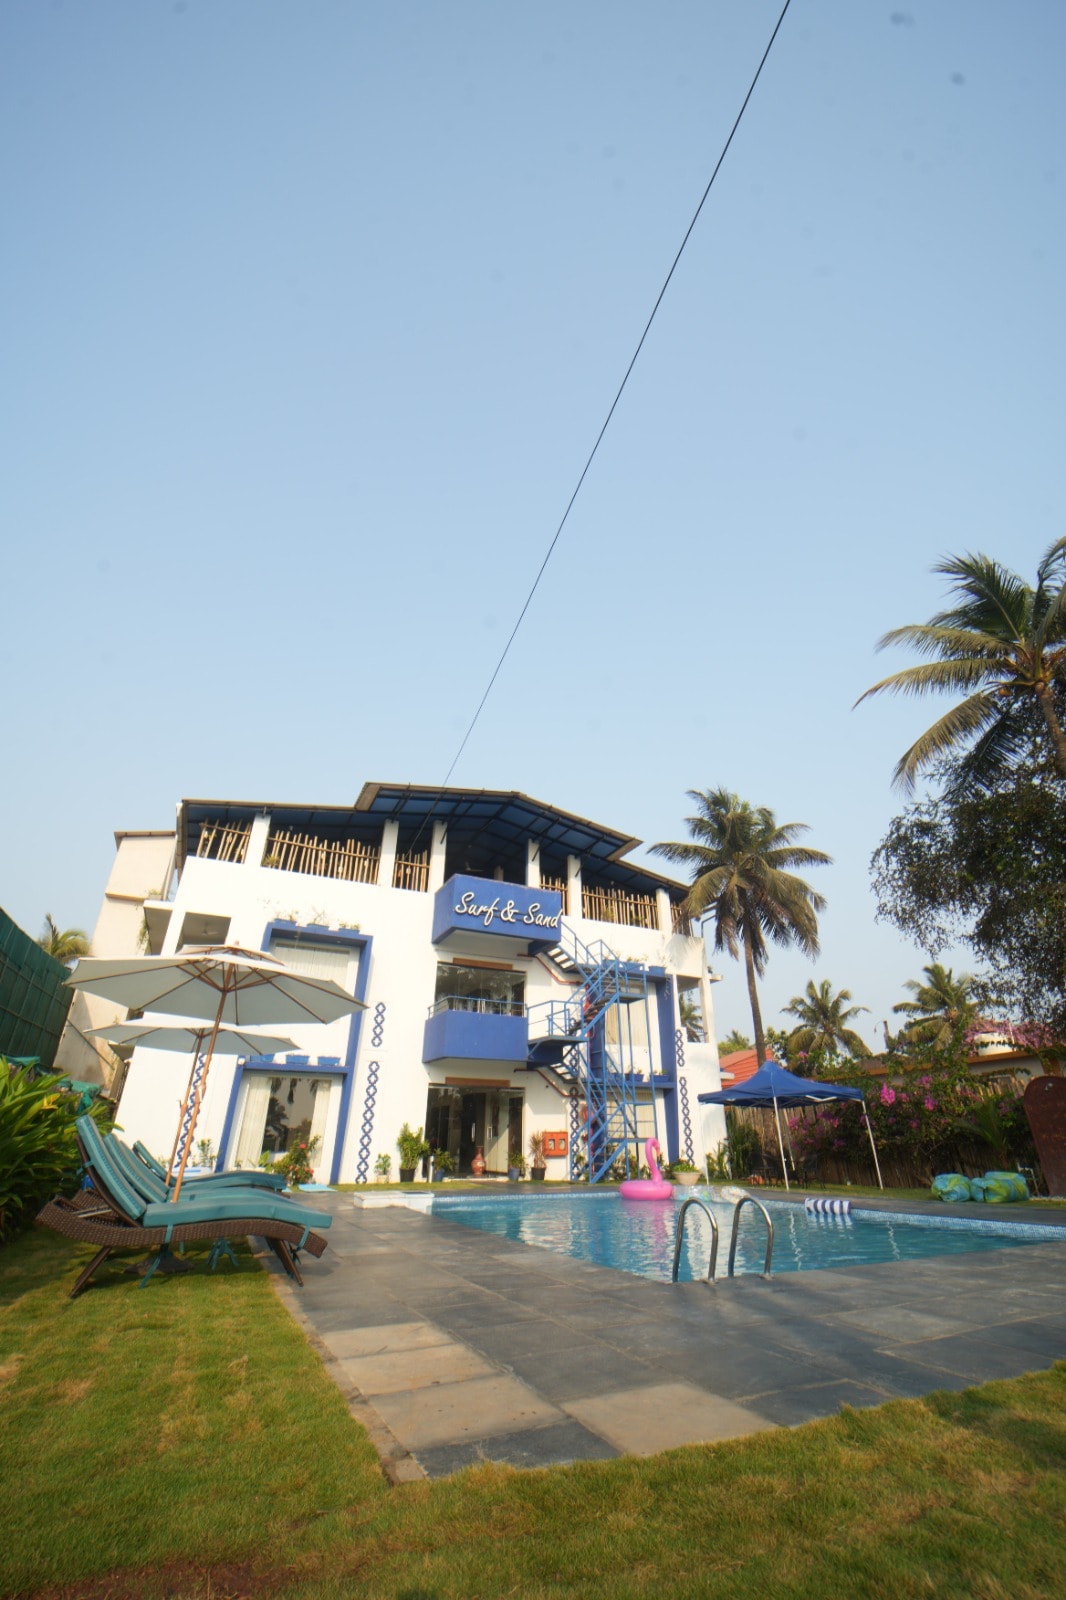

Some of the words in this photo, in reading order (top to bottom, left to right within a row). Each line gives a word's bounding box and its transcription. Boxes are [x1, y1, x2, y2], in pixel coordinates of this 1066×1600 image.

[454, 892, 500, 926] Surf
[500, 900, 519, 923] &
[523, 903, 563, 928] Sand
